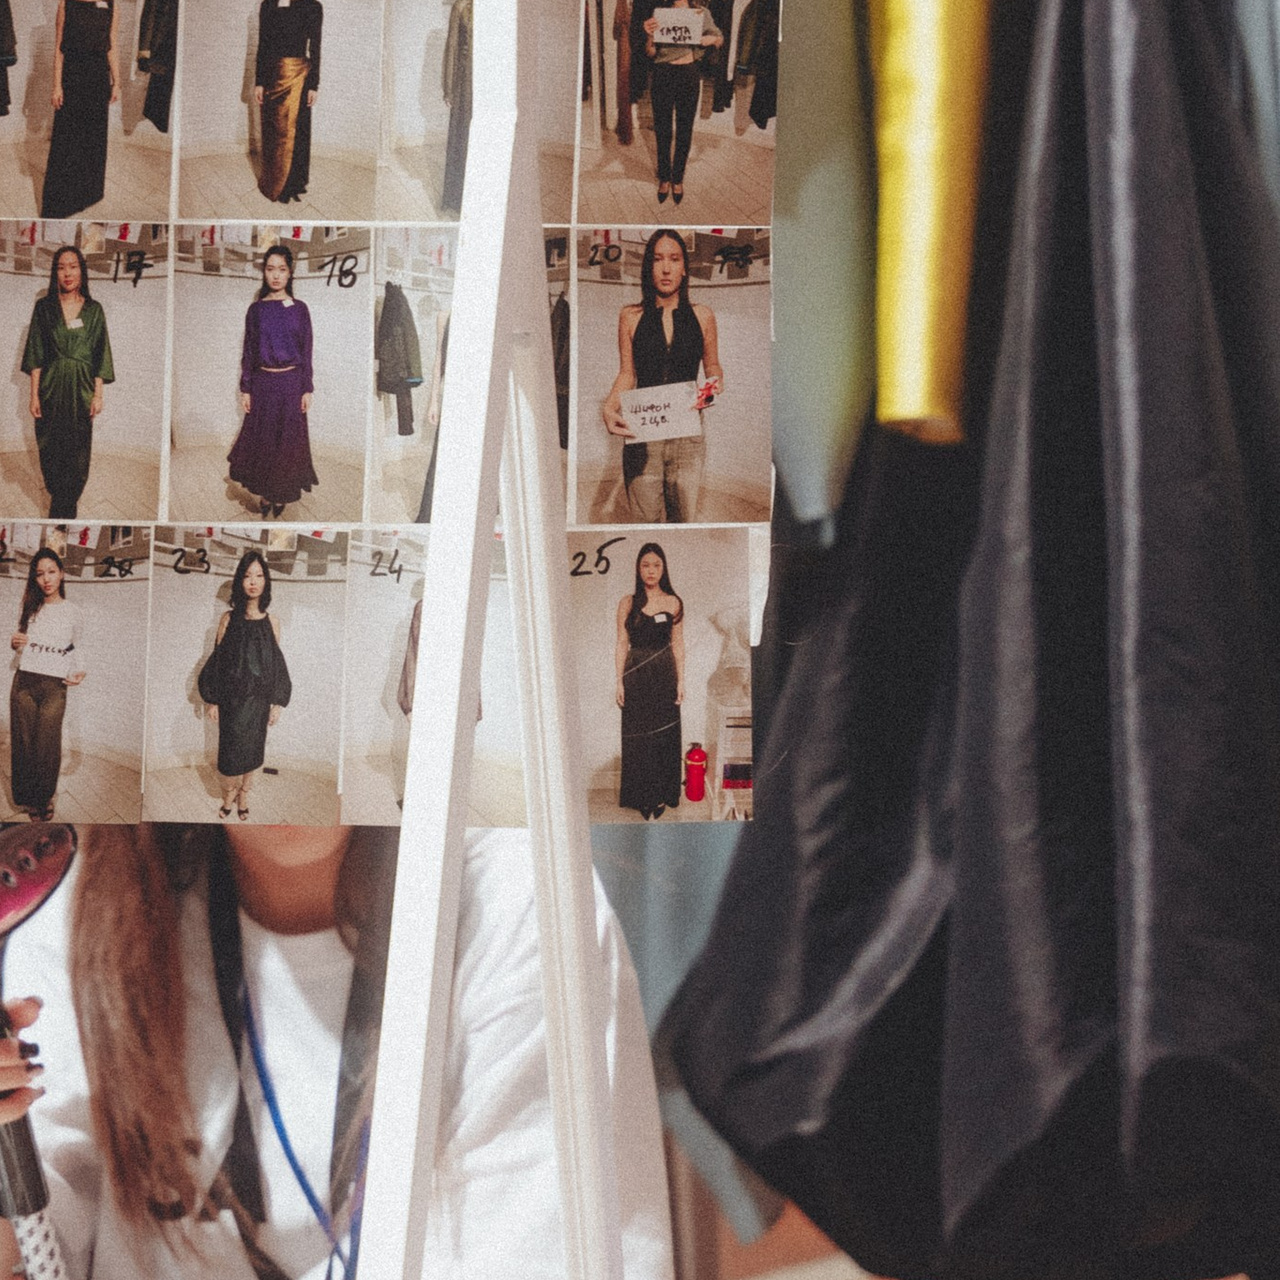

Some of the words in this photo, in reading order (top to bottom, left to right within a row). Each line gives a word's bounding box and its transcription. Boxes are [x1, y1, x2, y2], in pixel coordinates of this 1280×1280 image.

[113, 250, 153, 288] 17
[319, 254, 358, 288] 18
[589, 245, 622, 266] 20
[172, 548, 211, 574] 23
[370, 549, 403, 583] 24
[570, 537, 626, 576] 25
